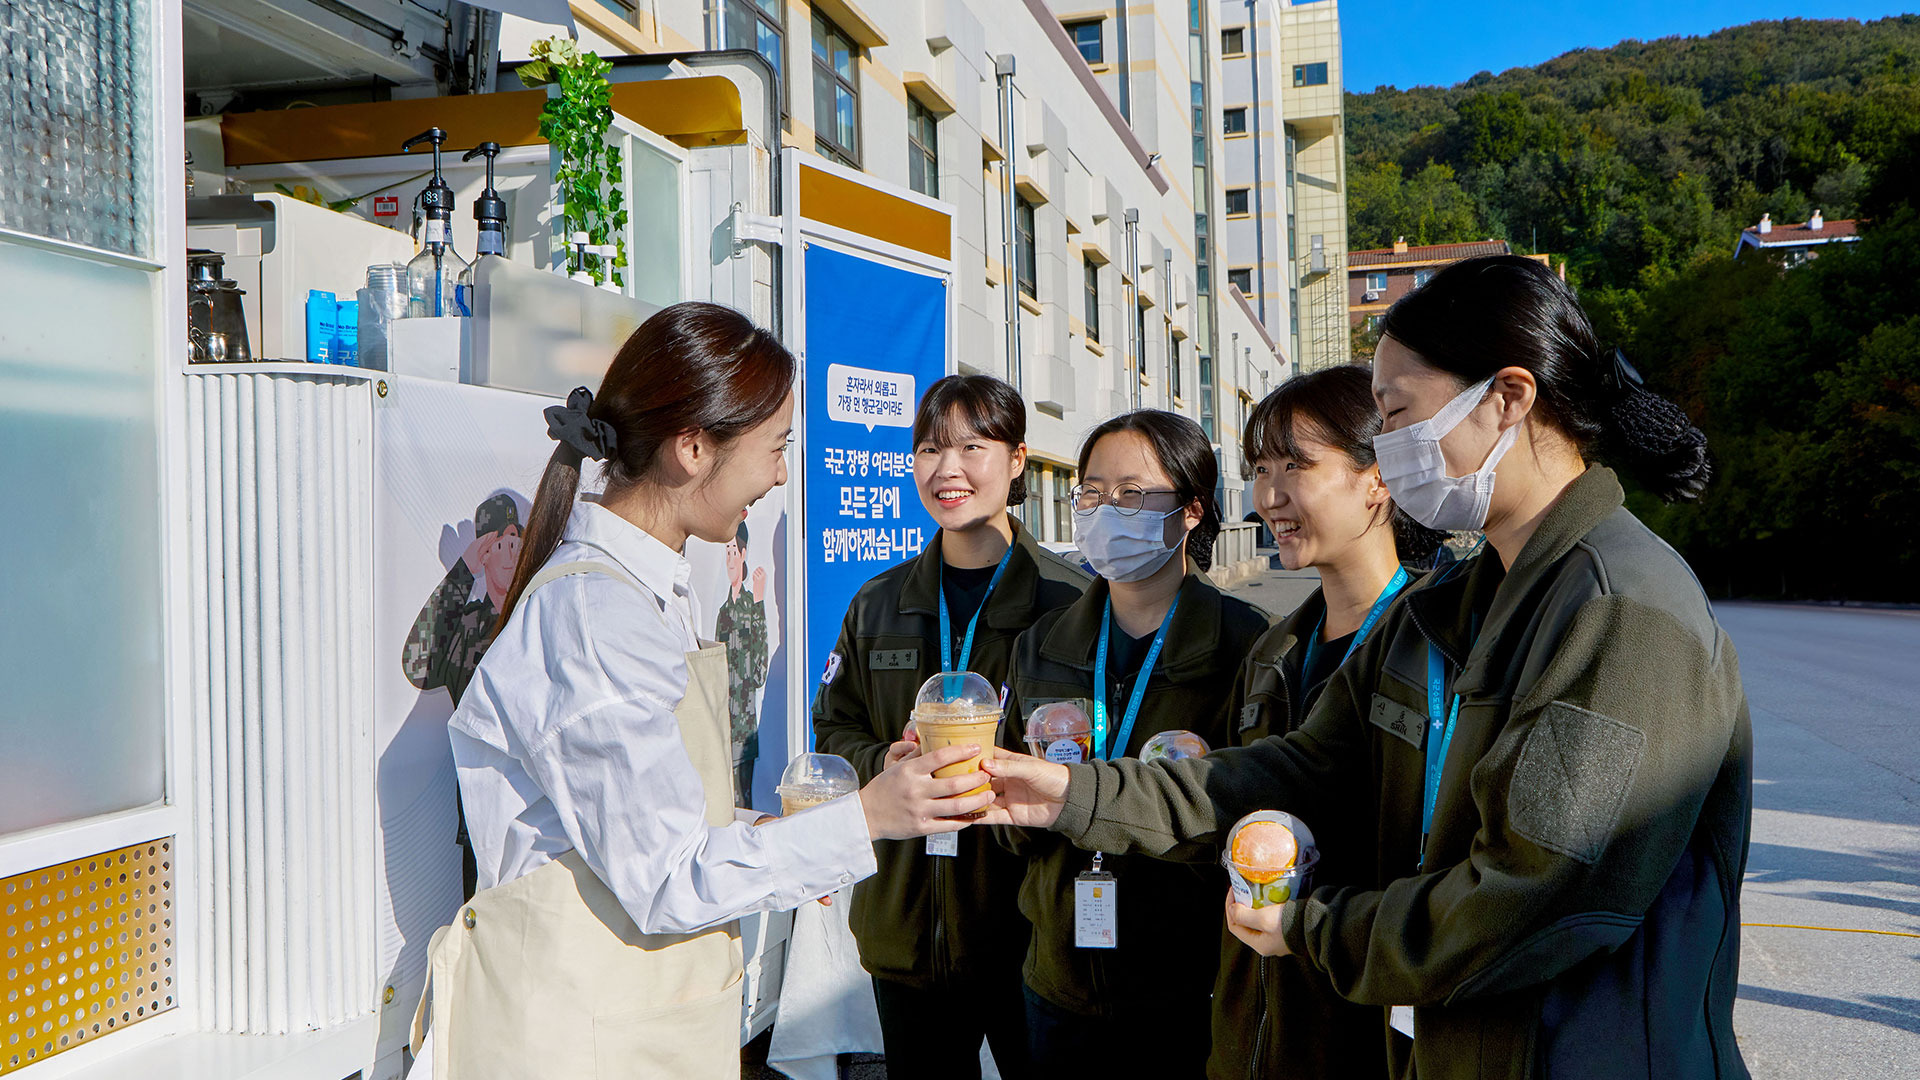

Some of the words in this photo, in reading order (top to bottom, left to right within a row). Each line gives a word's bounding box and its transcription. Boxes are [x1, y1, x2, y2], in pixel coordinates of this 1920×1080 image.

[846, 376, 873, 395] 혼자라서
[874, 380, 897, 397] 외롭고
[838, 394, 852, 412] 가장
[853, 396, 860, 413] 먼
[861, 397, 903, 416] 행군길이라도
[824, 448, 845, 475] 국군
[846, 449, 870, 477] 장병
[839, 486, 867, 519] 모든
[868, 486, 900, 519] 길에
[822, 527, 924, 563] 함께하겠습니다
